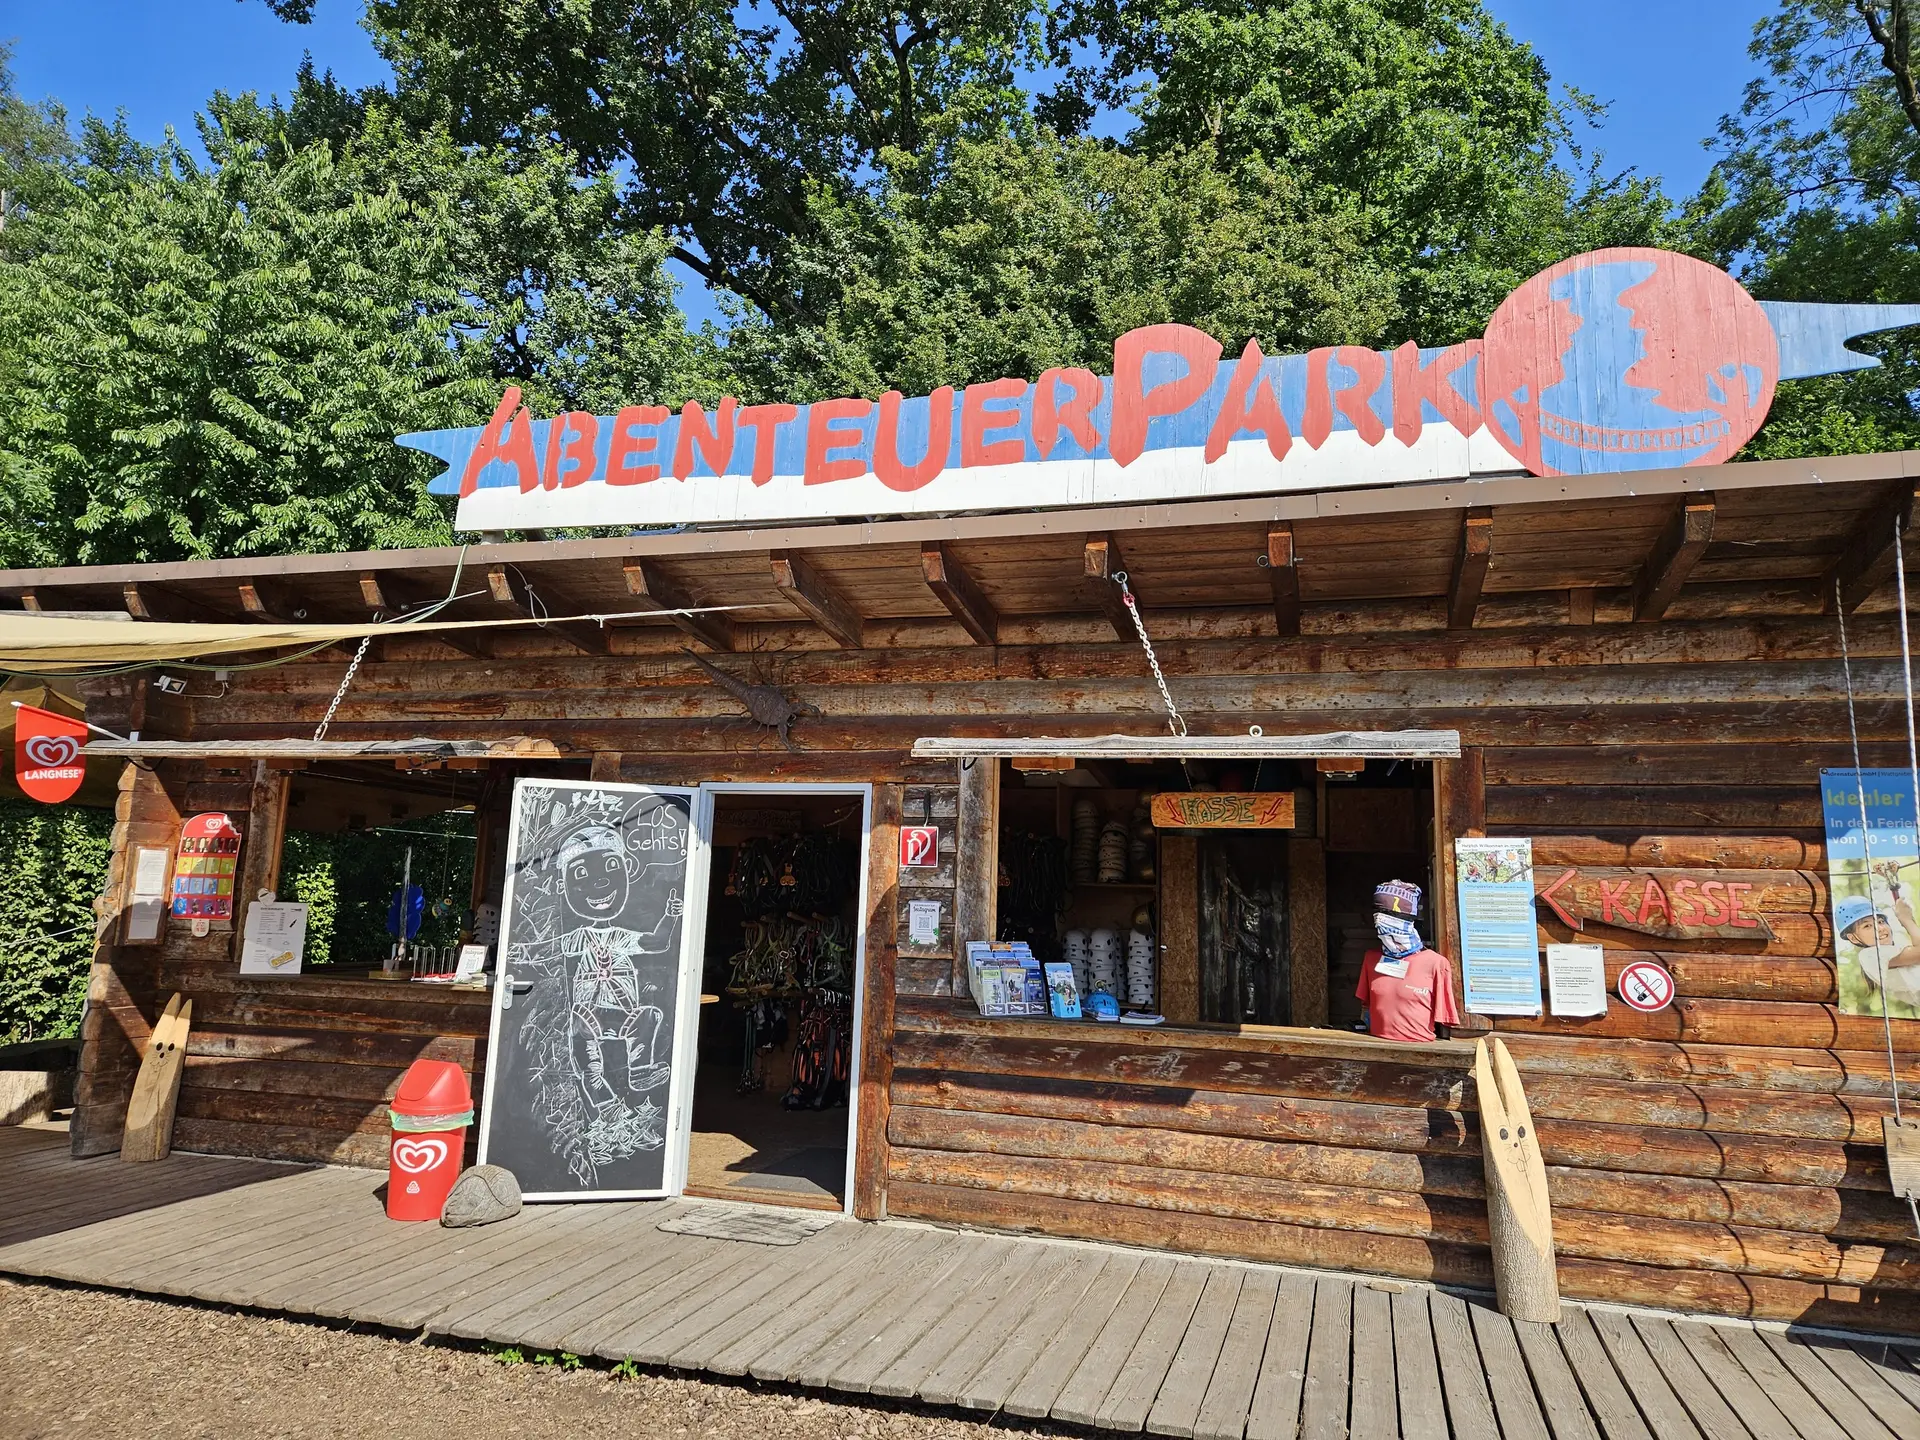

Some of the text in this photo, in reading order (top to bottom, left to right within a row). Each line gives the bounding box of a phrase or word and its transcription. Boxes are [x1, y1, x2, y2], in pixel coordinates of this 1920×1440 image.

[1826, 788, 1905, 807] Idealer
[637, 804, 677, 829] LOS
[1180, 796, 1258, 825] KASSE
[1830, 818, 1844, 828] In
[1847, 818, 1873, 828] den
[626, 828, 687, 856] Gehts!
[1832, 835, 1858, 845] von
[1891, 834, 1908, 845] 19
[1600, 879, 1758, 928] KASSE
